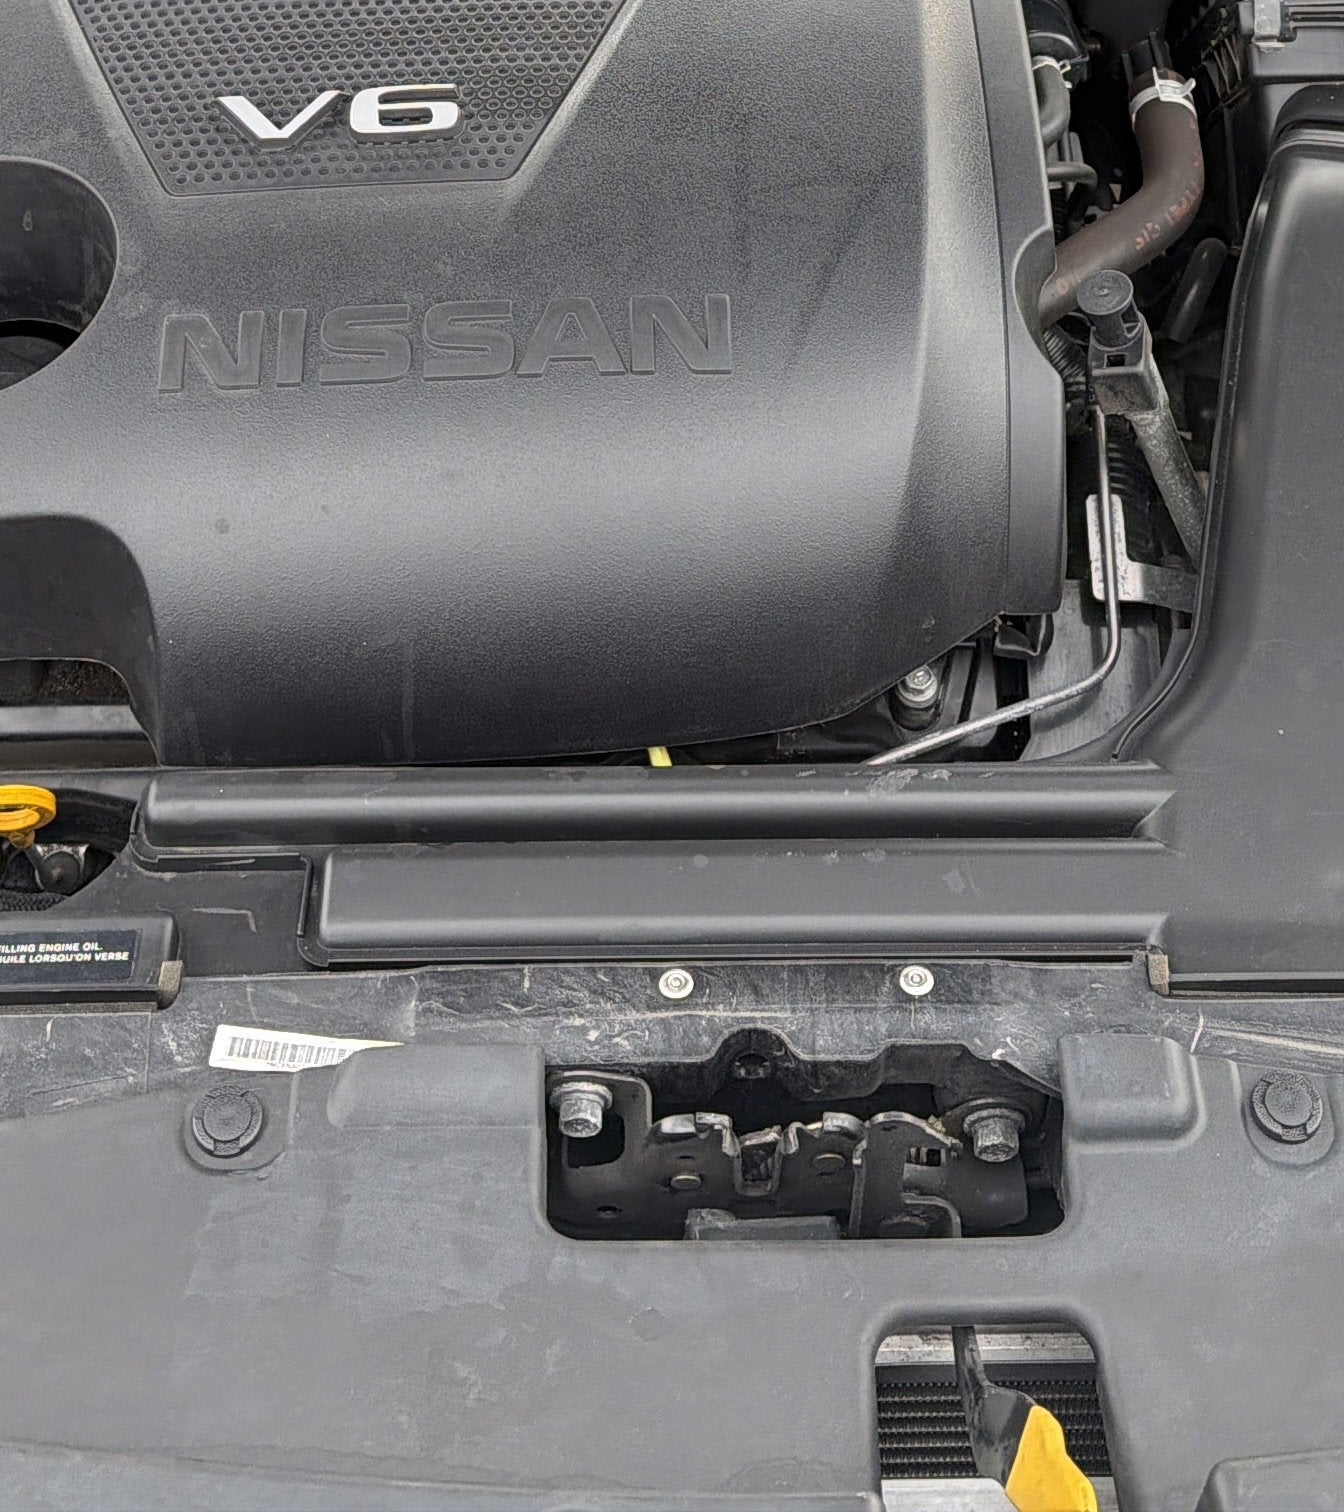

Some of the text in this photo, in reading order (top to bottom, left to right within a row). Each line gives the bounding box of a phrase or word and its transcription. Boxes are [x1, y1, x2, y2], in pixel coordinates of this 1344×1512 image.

[217, 84, 460, 144] V6
[159, 293, 732, 393] NISSAN
[28, 953, 92, 963] LORSQU'ON
[94, 951, 129, 961] VERSE
[38, 943, 80, 953] ENGINE
[82, 942, 104, 951] OIL.
